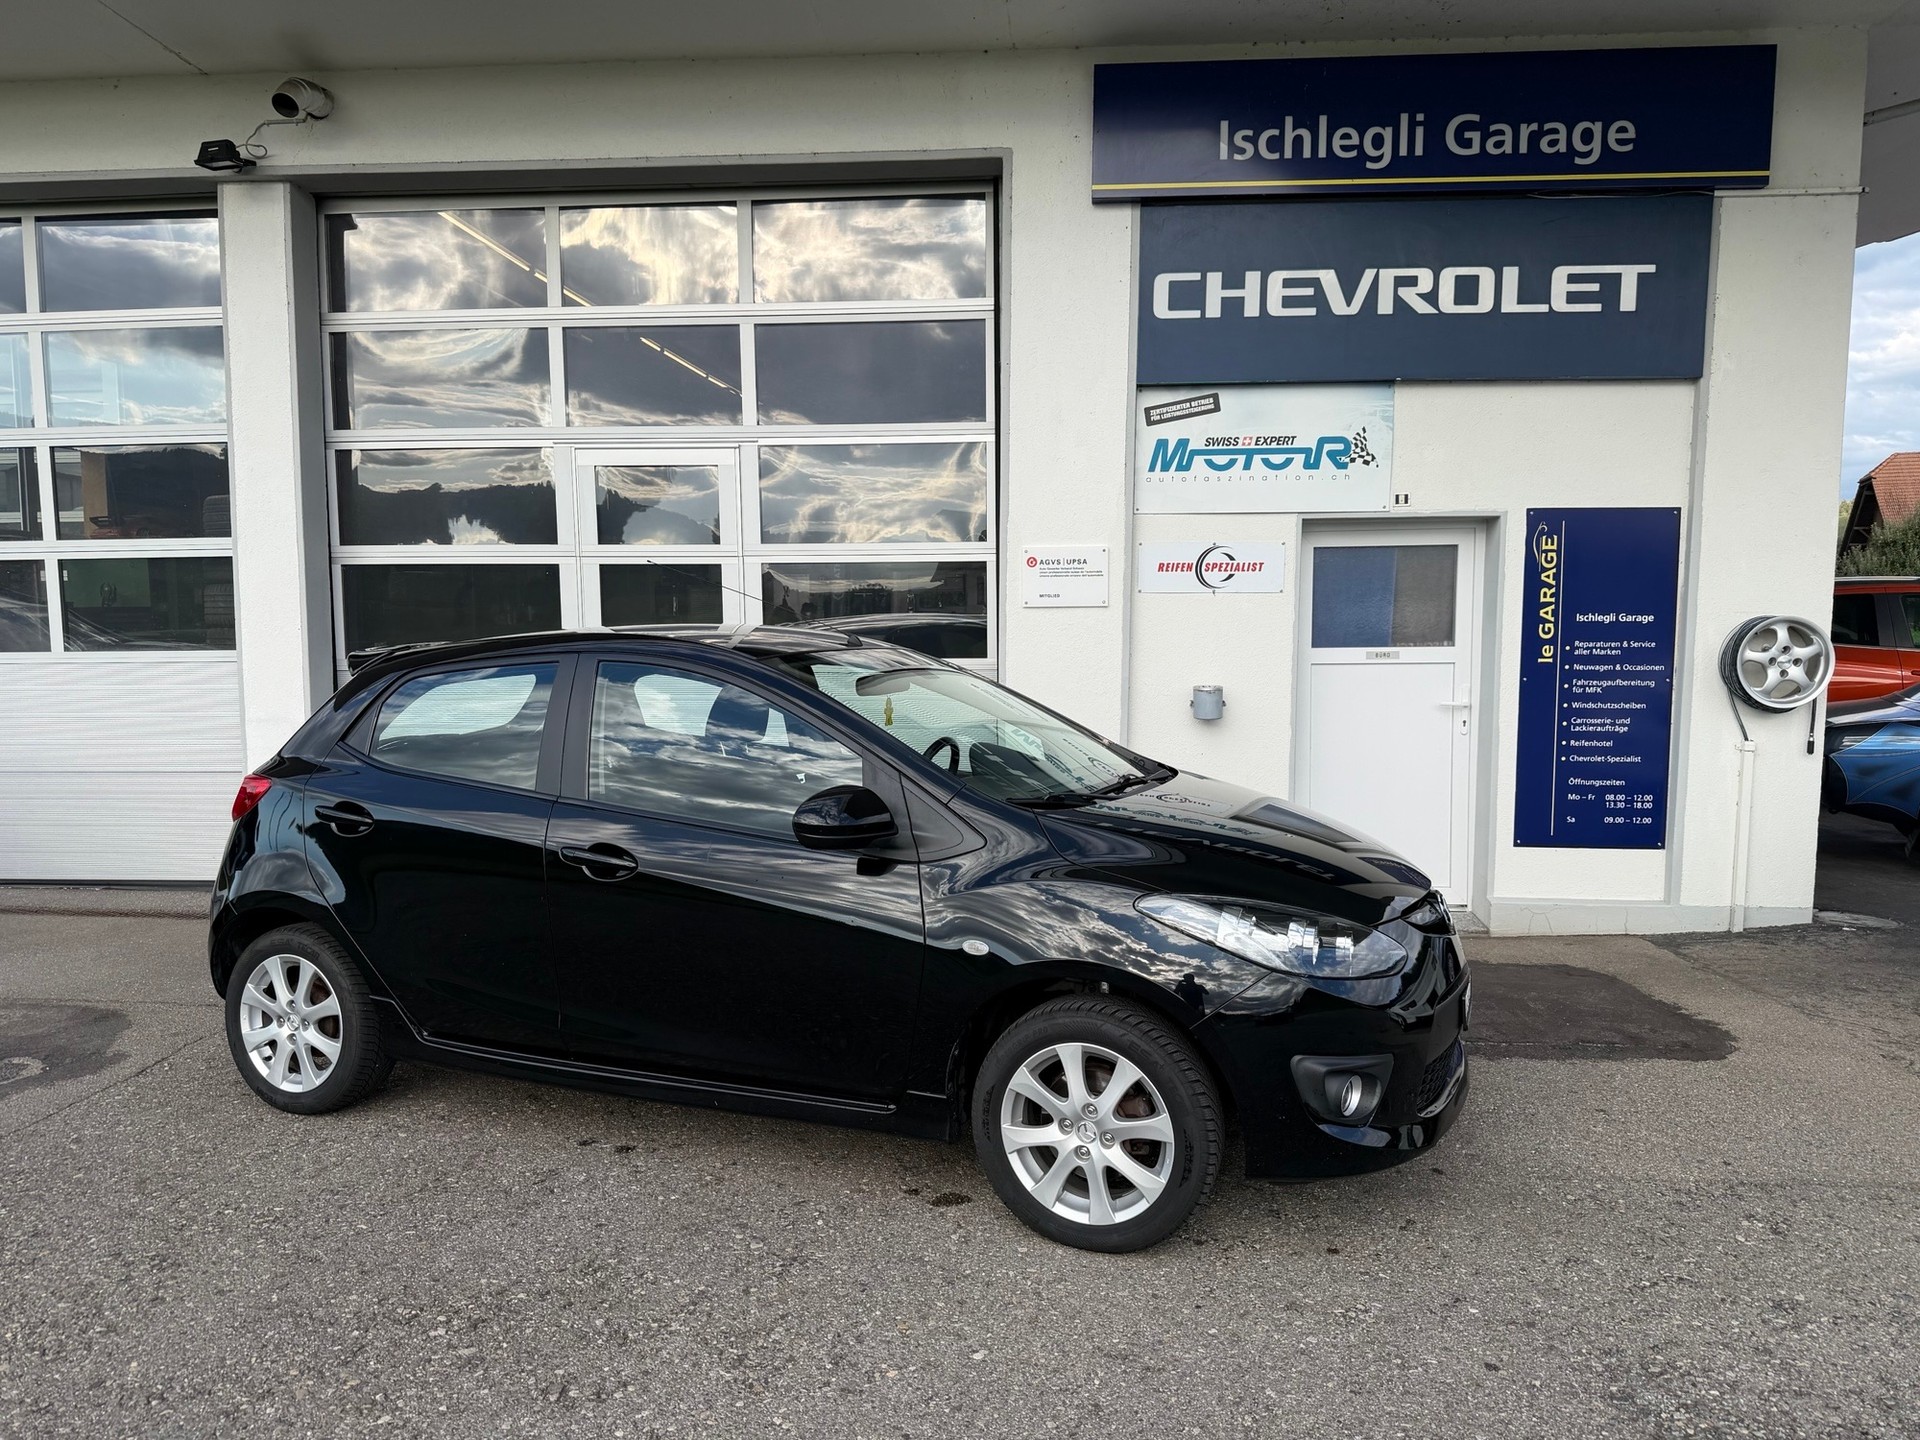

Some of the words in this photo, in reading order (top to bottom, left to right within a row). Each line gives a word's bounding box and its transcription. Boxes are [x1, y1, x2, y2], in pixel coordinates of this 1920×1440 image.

[1219, 113, 1424, 170] Ischlegli
[1445, 113, 1636, 165] Garage
[1153, 264, 1656, 319] CHEVROLET
[1204, 436, 1240, 447] SWISS
[1254, 436, 1297, 446] EXPERT
[1148, 436, 1351, 472] MOTOR
[1146, 474, 1350, 483] autofaszination.ch
[1158, 562, 1193, 572] REIFEN
[1204, 562, 1264, 572] SPEZIALIST
[1538, 534, 1558, 639] GARAGE
[1576, 613, 1616, 624] Ischlegli
[1619, 614, 1654, 624] Garage
[1574, 640, 1620, 649] Reparaturen
[1630, 640, 1656, 648] Service
[1538, 645, 1554, 663] le
[1574, 664, 1613, 672] Neuwagen
[1573, 679, 1655, 687] Fahrzeugaufbereitung
[1571, 725, 1628, 733] Lackieraufträge
[1569, 755, 1641, 763] Chevrolet-Spezialist
[1568, 777, 1625, 787] Öffnungszeiten
